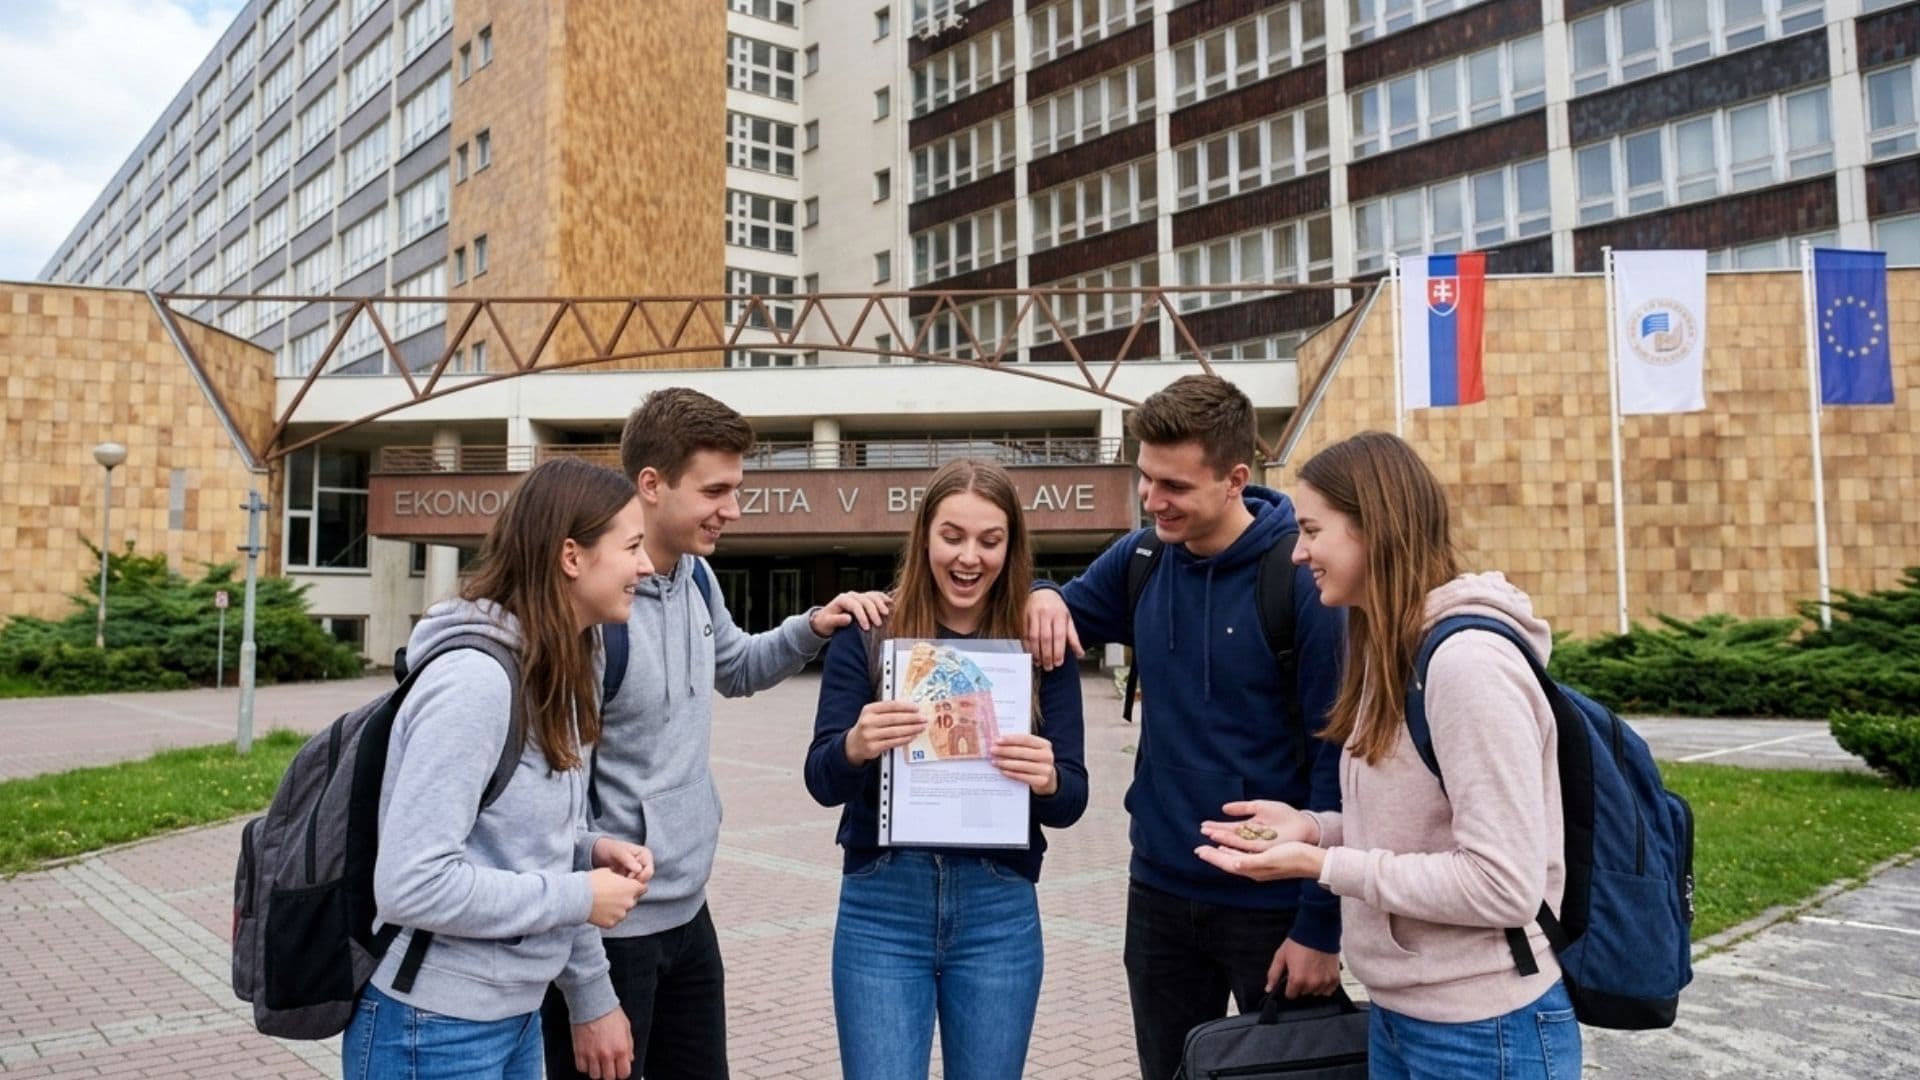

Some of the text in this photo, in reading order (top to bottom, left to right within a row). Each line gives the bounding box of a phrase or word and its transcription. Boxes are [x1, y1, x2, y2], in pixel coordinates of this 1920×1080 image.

[395, 490, 510, 514] EKONO
[736, 487, 811, 513] ZITA
[837, 487, 859, 512] V
[935, 714, 953, 729] 10
